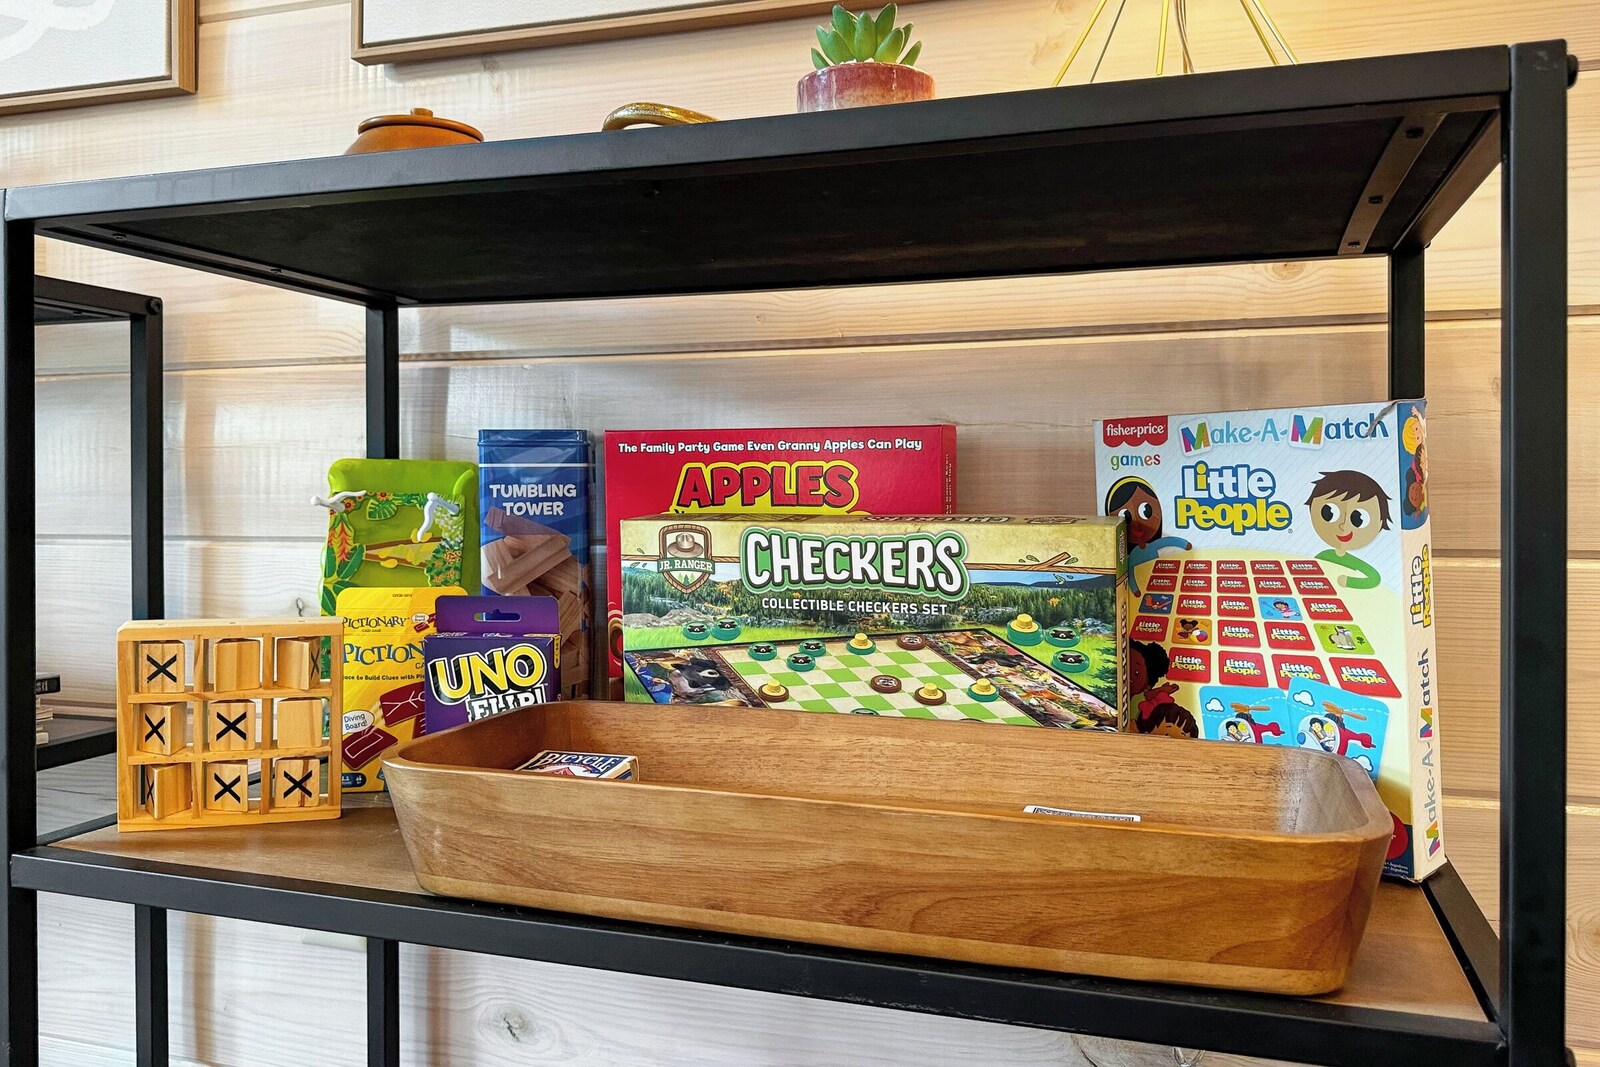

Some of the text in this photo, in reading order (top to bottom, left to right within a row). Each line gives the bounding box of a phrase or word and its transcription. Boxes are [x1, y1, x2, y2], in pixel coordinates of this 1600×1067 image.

[1106, 423, 1164, 437] fisher-price
[618, 438, 922, 454] The Family Party Game Even Granny Apples Can Play
[1110, 454, 1161, 471] games
[676, 465, 856, 509] APPLES
[1182, 461, 1276, 499] Little
[489, 483, 577, 498] TUMBLING
[502, 501, 564, 516] TOWER
[1175, 497, 1292, 535] People
[659, 560, 713, 572] JR. RANGER
[745, 531, 962, 596] CHECKERS
[761, 597, 948, 616] COLLECTIBLE CHECKERS SET
[1175, 656, 1202, 664] Little
[1226, 659, 1255, 668] Little
[430, 645, 546, 702] UNO
[1342, 666, 1377, 676] Little
[344, 713, 366, 723] Diving
[345, 719, 368, 731] Board!
[540, 752, 620, 772] BICYCLE
